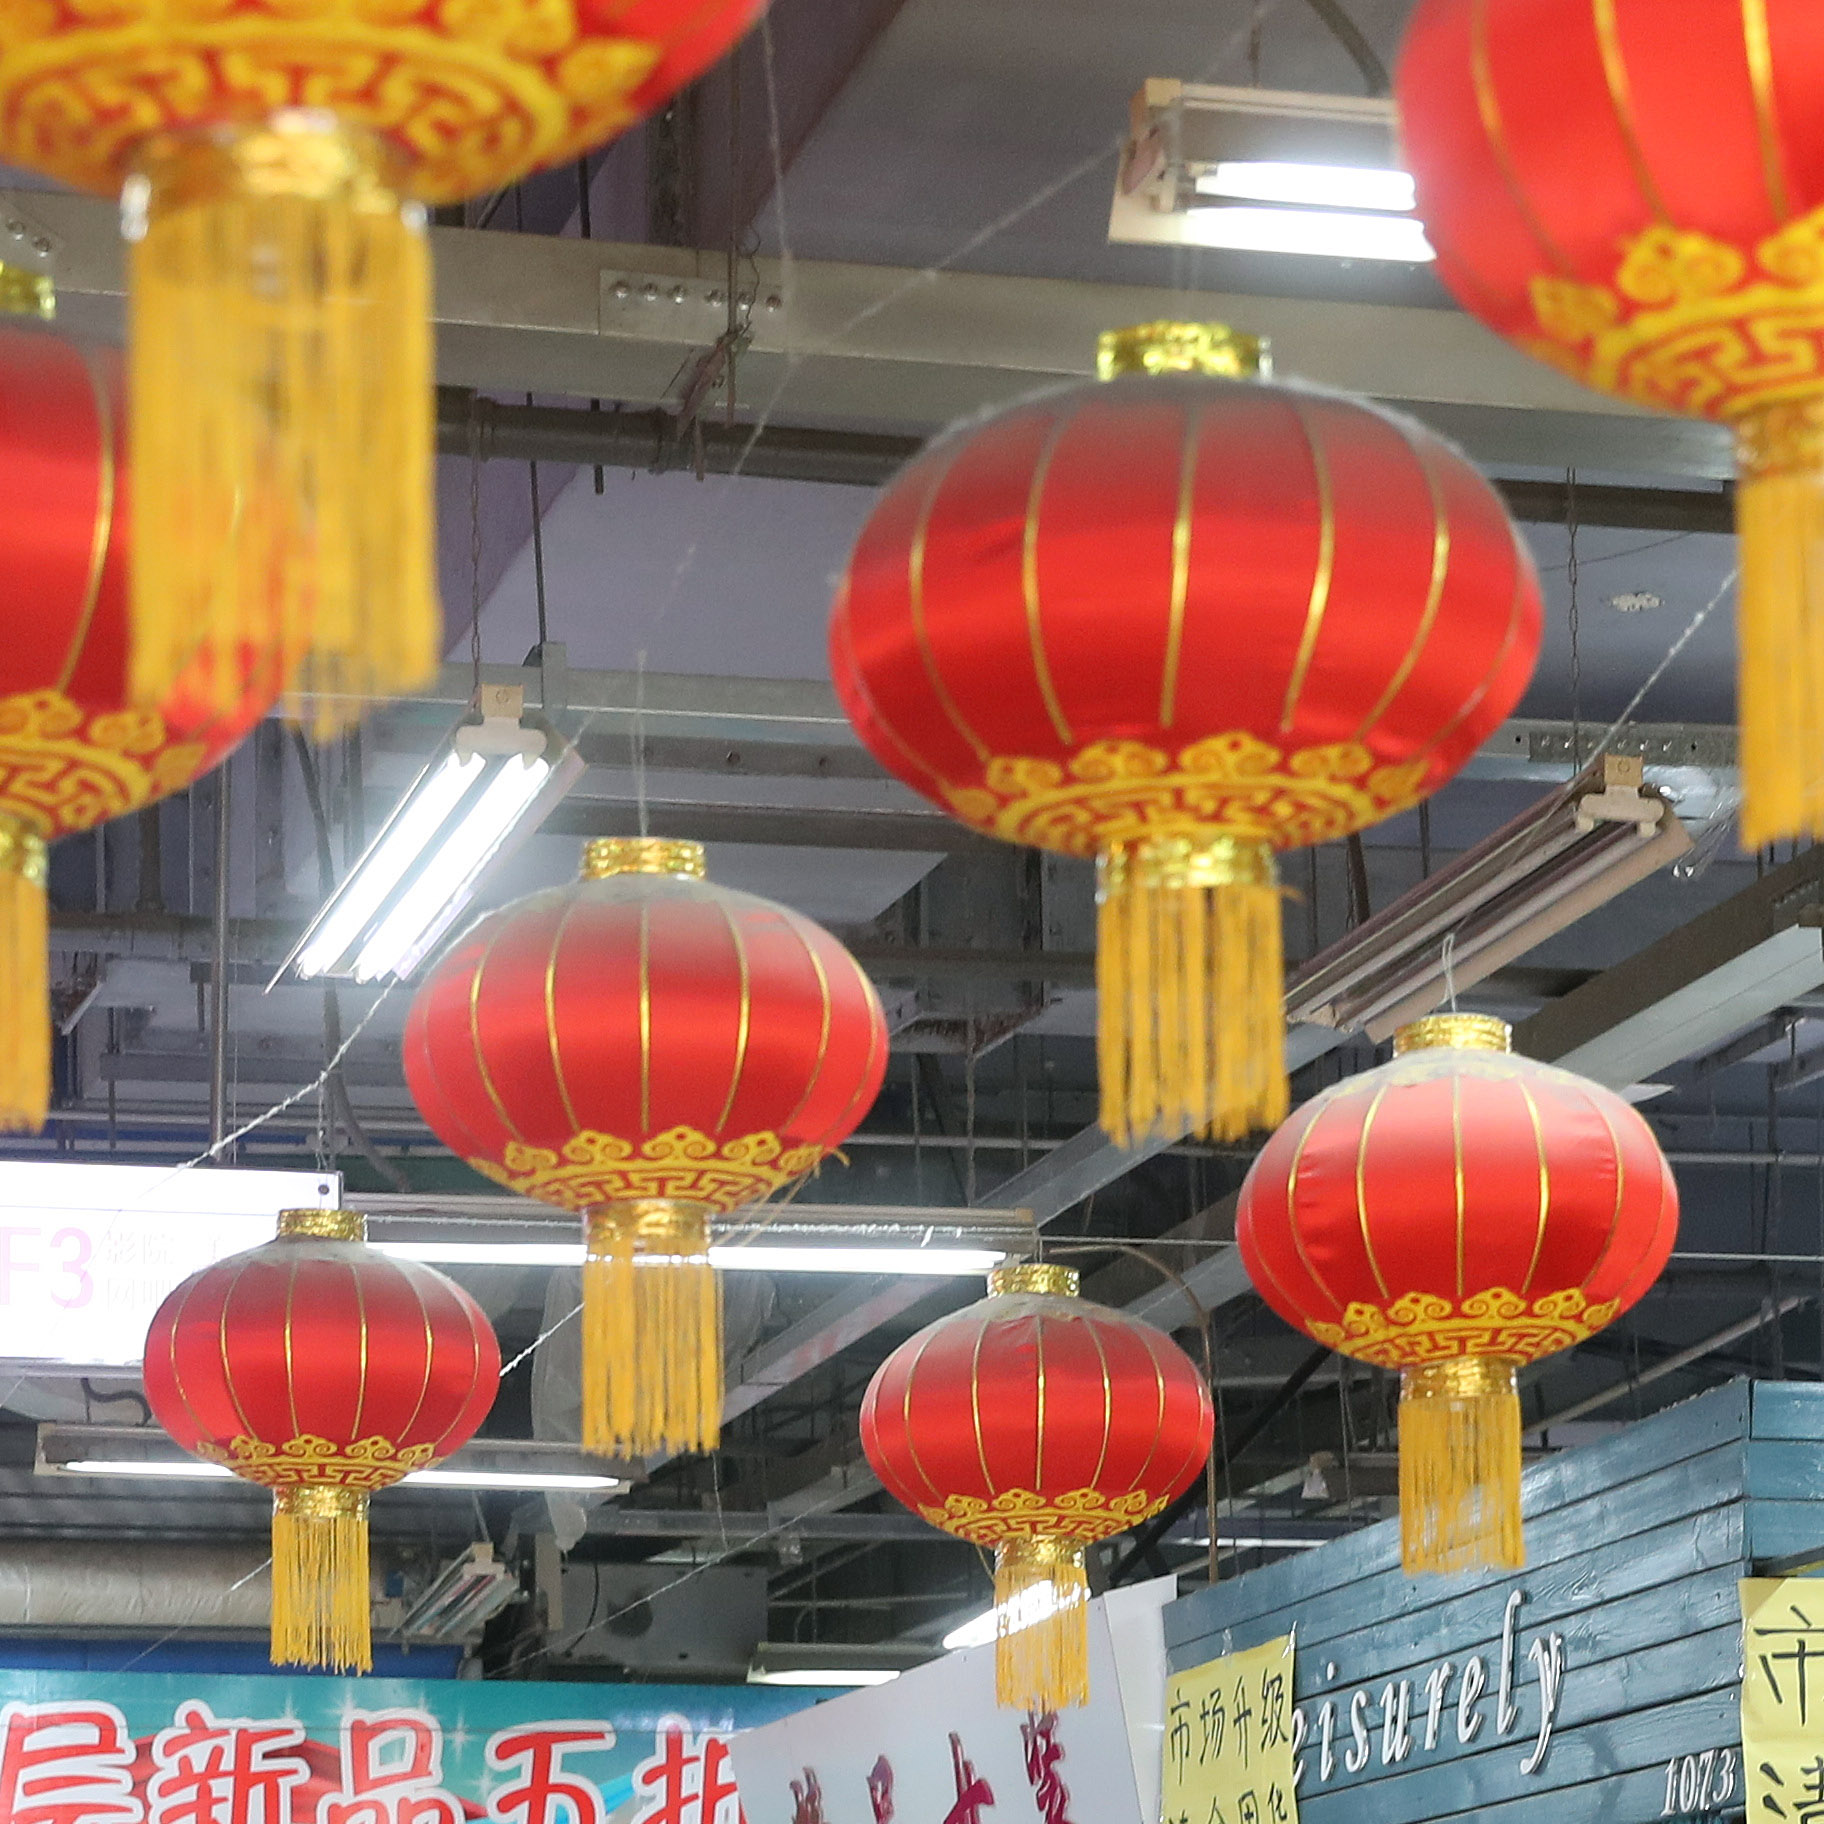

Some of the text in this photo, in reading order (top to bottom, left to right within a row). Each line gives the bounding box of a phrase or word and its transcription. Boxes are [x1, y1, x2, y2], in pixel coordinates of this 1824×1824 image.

[1168, 1666, 1291, 1786] 市场升级
[1660, 1748, 1736, 1816] 1073
